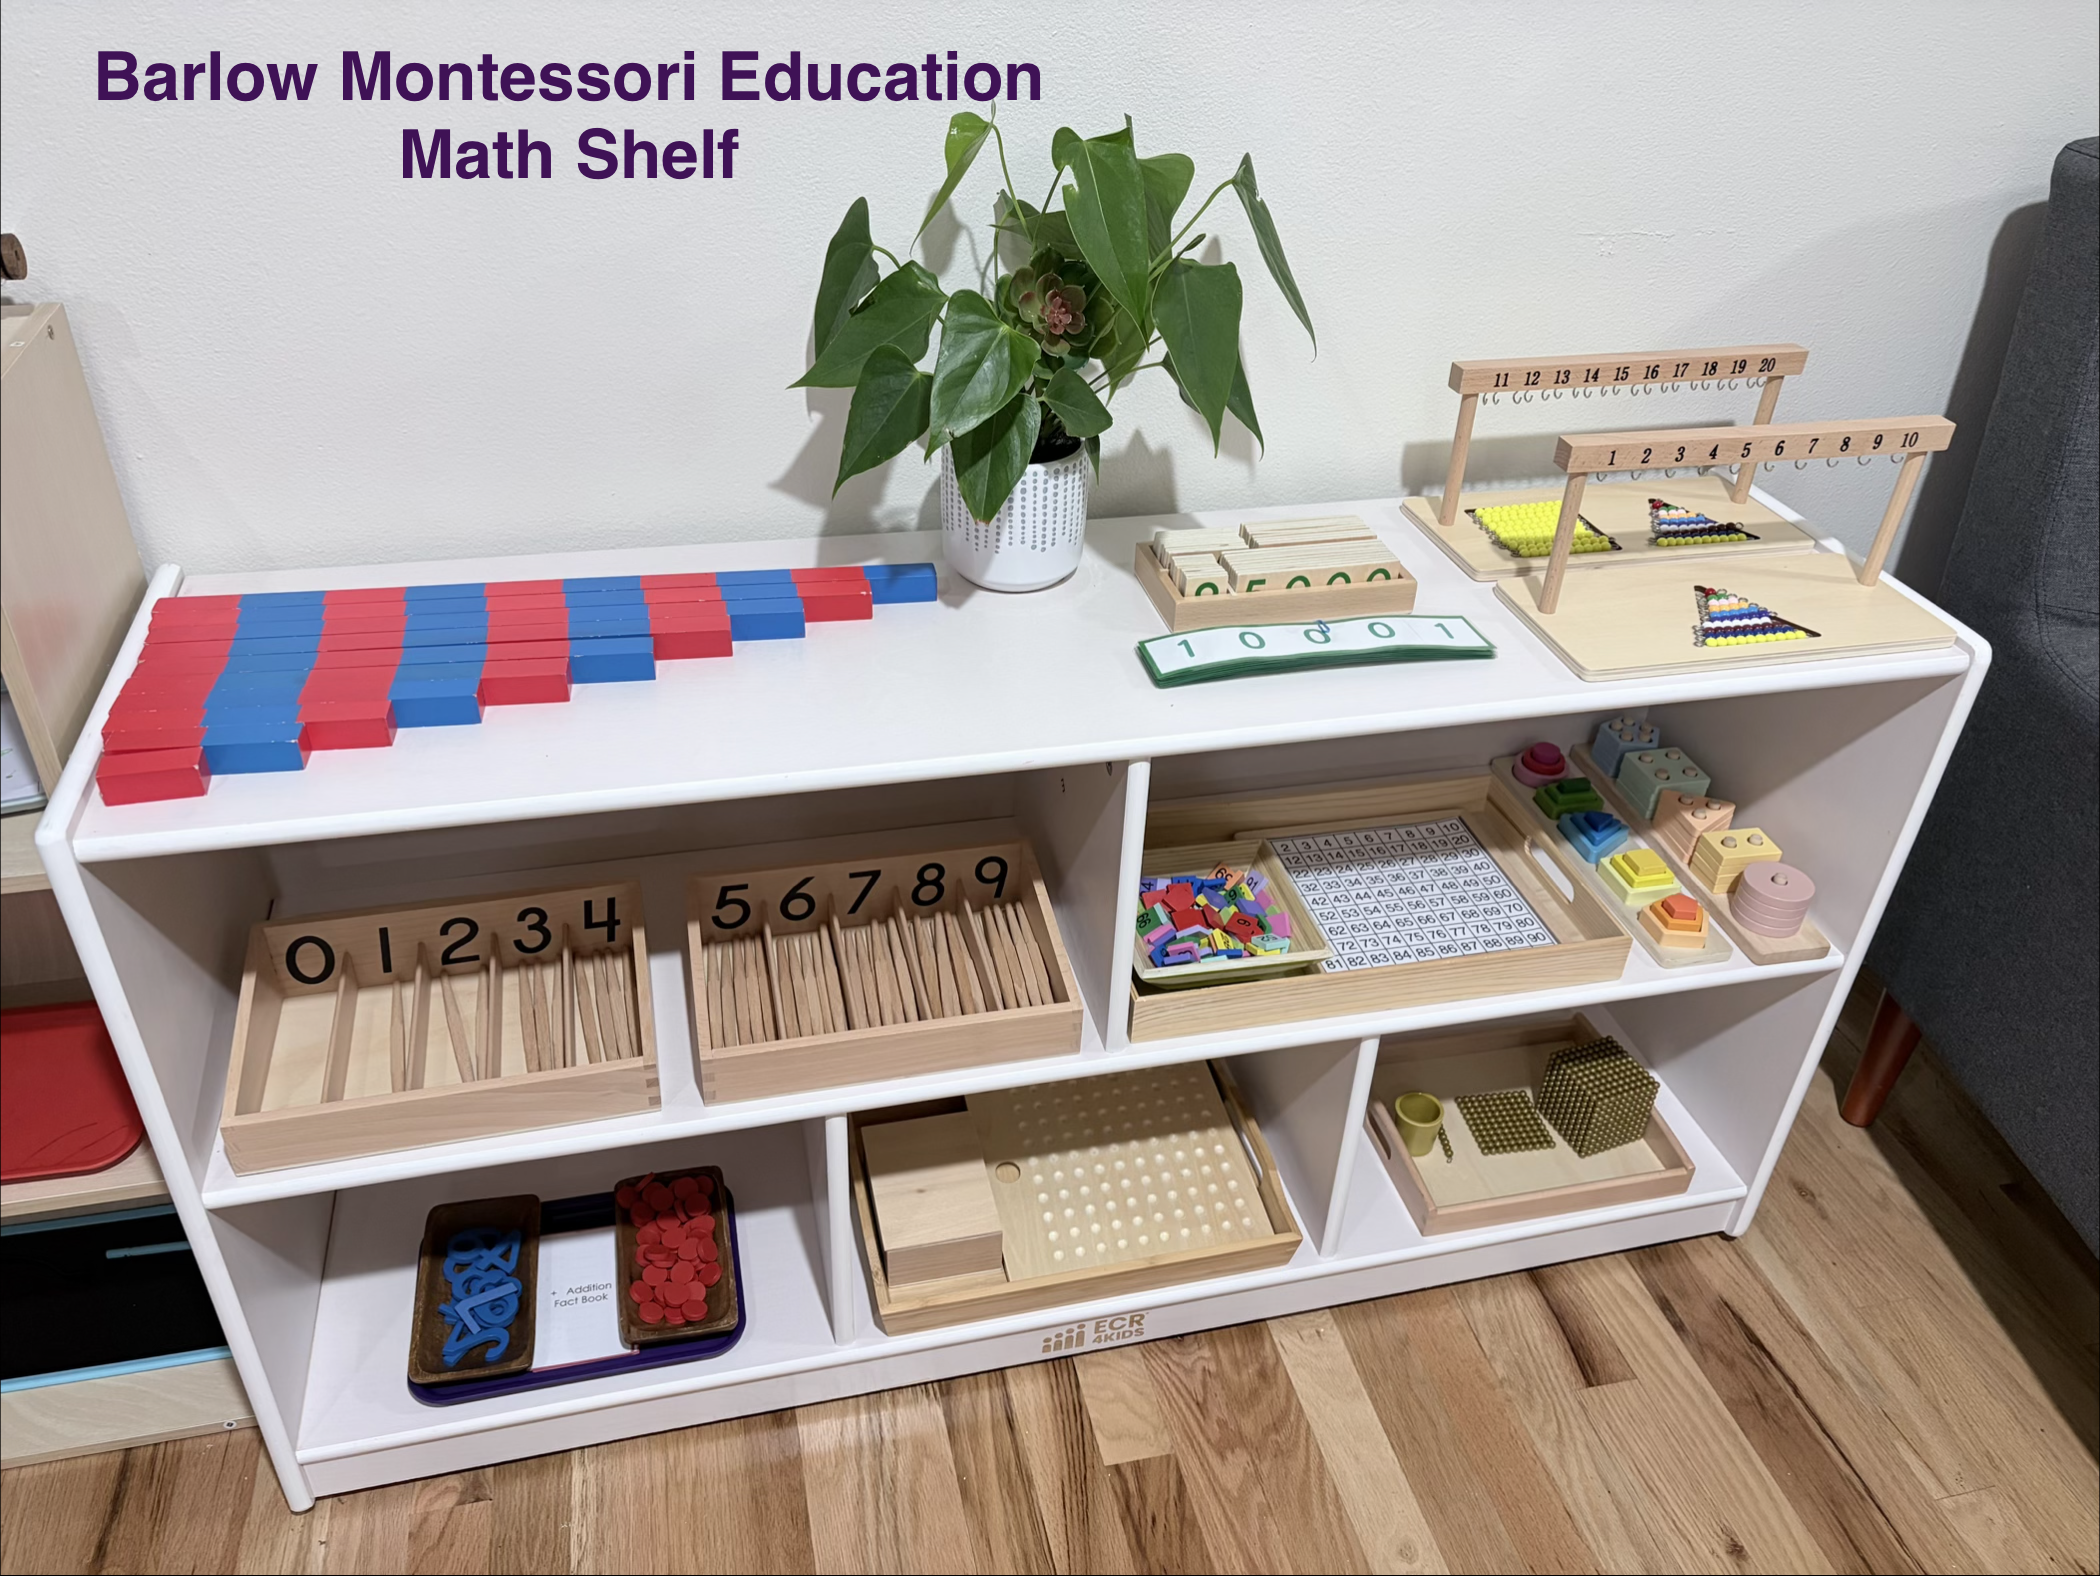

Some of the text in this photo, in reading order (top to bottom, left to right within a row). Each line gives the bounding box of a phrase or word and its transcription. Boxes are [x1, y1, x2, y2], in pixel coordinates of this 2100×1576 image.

[1494, 358, 1776, 387] 11 12 13 14 15 16 17 18 19 20
[1608, 432, 1918, 465] 1 2 3 4 5 6 7 8 9 10
[1284, 836, 1470, 865] 12 13 14 15 16 17 18 19 20
[1293, 848, 1480, 879] 22 23 24 25 26 27 28 29 30
[711, 855, 1008, 930] 5 6 7 8 9
[1301, 862, 1490, 892] 32 33 34 35 36 37 38 39 40
[1310, 875, 1501, 907] 42 43 44 45 46 47 48 49 50
[1319, 889, 1512, 921] 52 53 54 55 56 57 58 59 60
[1328, 903, 1523, 936] 62 63 64 65 66 67 68 69 70
[286, 897, 621, 984] 0 1 2 3 4
[1325, 931, 1546, 969] 81 82 83 84 85 86 87 88 89 90
[1338, 918, 1534, 951] 72 73 74 75 76 77 78 79 80
[554, 1293, 608, 1307] Fact Book
[566, 1282, 612, 1295] Addition
[1092, 1328, 1144, 1343] 4KIDS
[1094, 1313, 1145, 1334] ECR
